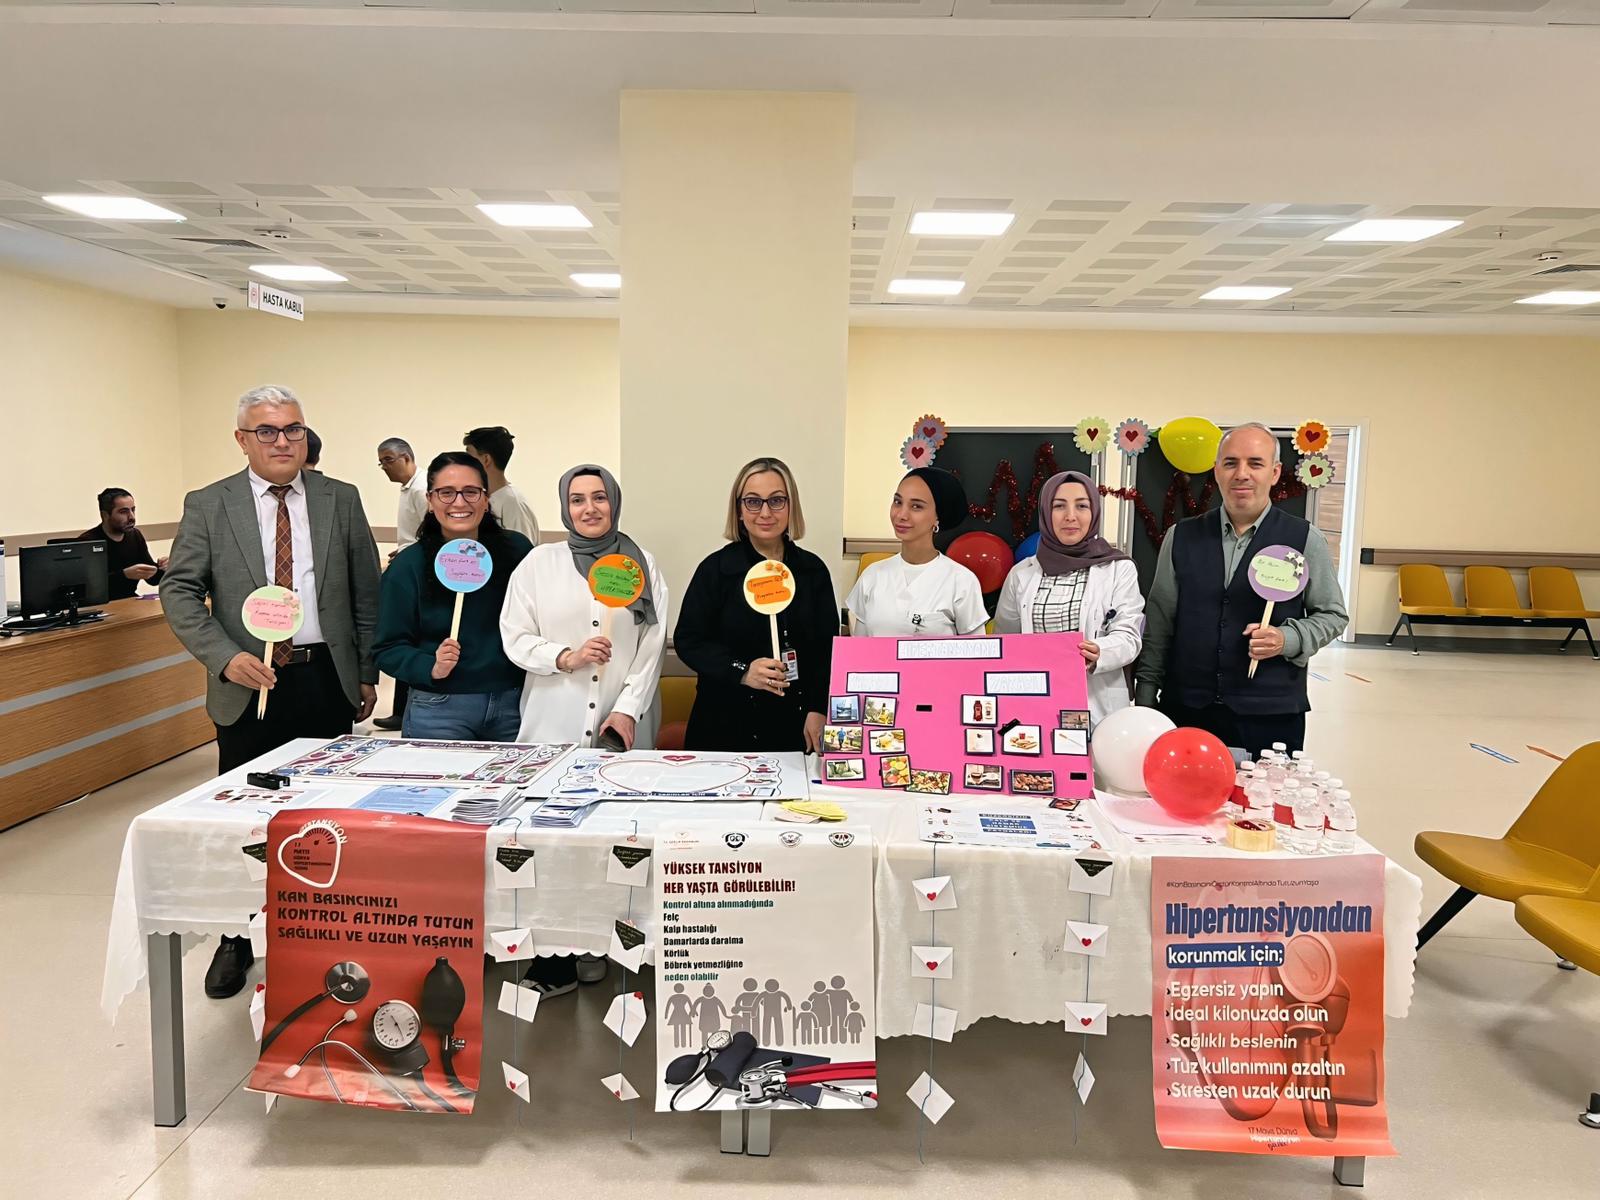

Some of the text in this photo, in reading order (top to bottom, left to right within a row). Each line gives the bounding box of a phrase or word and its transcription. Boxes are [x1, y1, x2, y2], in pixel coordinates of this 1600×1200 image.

[263, 292, 302, 314] HASTA KABUL
[663, 860, 762, 875] YÜKSEK TANSİYON
[663, 879, 796, 895] HER YAŞTA GÖRÜLEBİLİR!
[277, 891, 398, 908] KAN BASINCINIZI
[663, 899, 773, 909] Kontrol altına alınmadığında
[277, 908, 474, 930] KONTROL ALTINDA TUTUN
[664, 912, 680, 922] Felç
[1165, 901, 1372, 938] Hipertansiyondan
[278, 925, 474, 949] SAĞLIKLI VE UZUN YAŞAYIN
[664, 924, 717, 935] Kalp hastalığı
[664, 936, 744, 946] Damarlarda daralma
[664, 948, 690, 958] Körlük
[1169, 945, 1284, 964] korunmak için;
[664, 960, 743, 970] Böbrek yetmezliğine
[664, 972, 719, 981] neden olabilir
[1171, 982, 1284, 1003] Egzersiz yapın
[1170, 1005, 1328, 1022] İdeal kilonuzda olun
[1170, 1033, 1297, 1052] Sağlıklı beslenin
[1171, 1058, 1345, 1076] Tuz kullanımını azaltın
[1170, 1082, 1331, 1100] Stresten uzak durun
